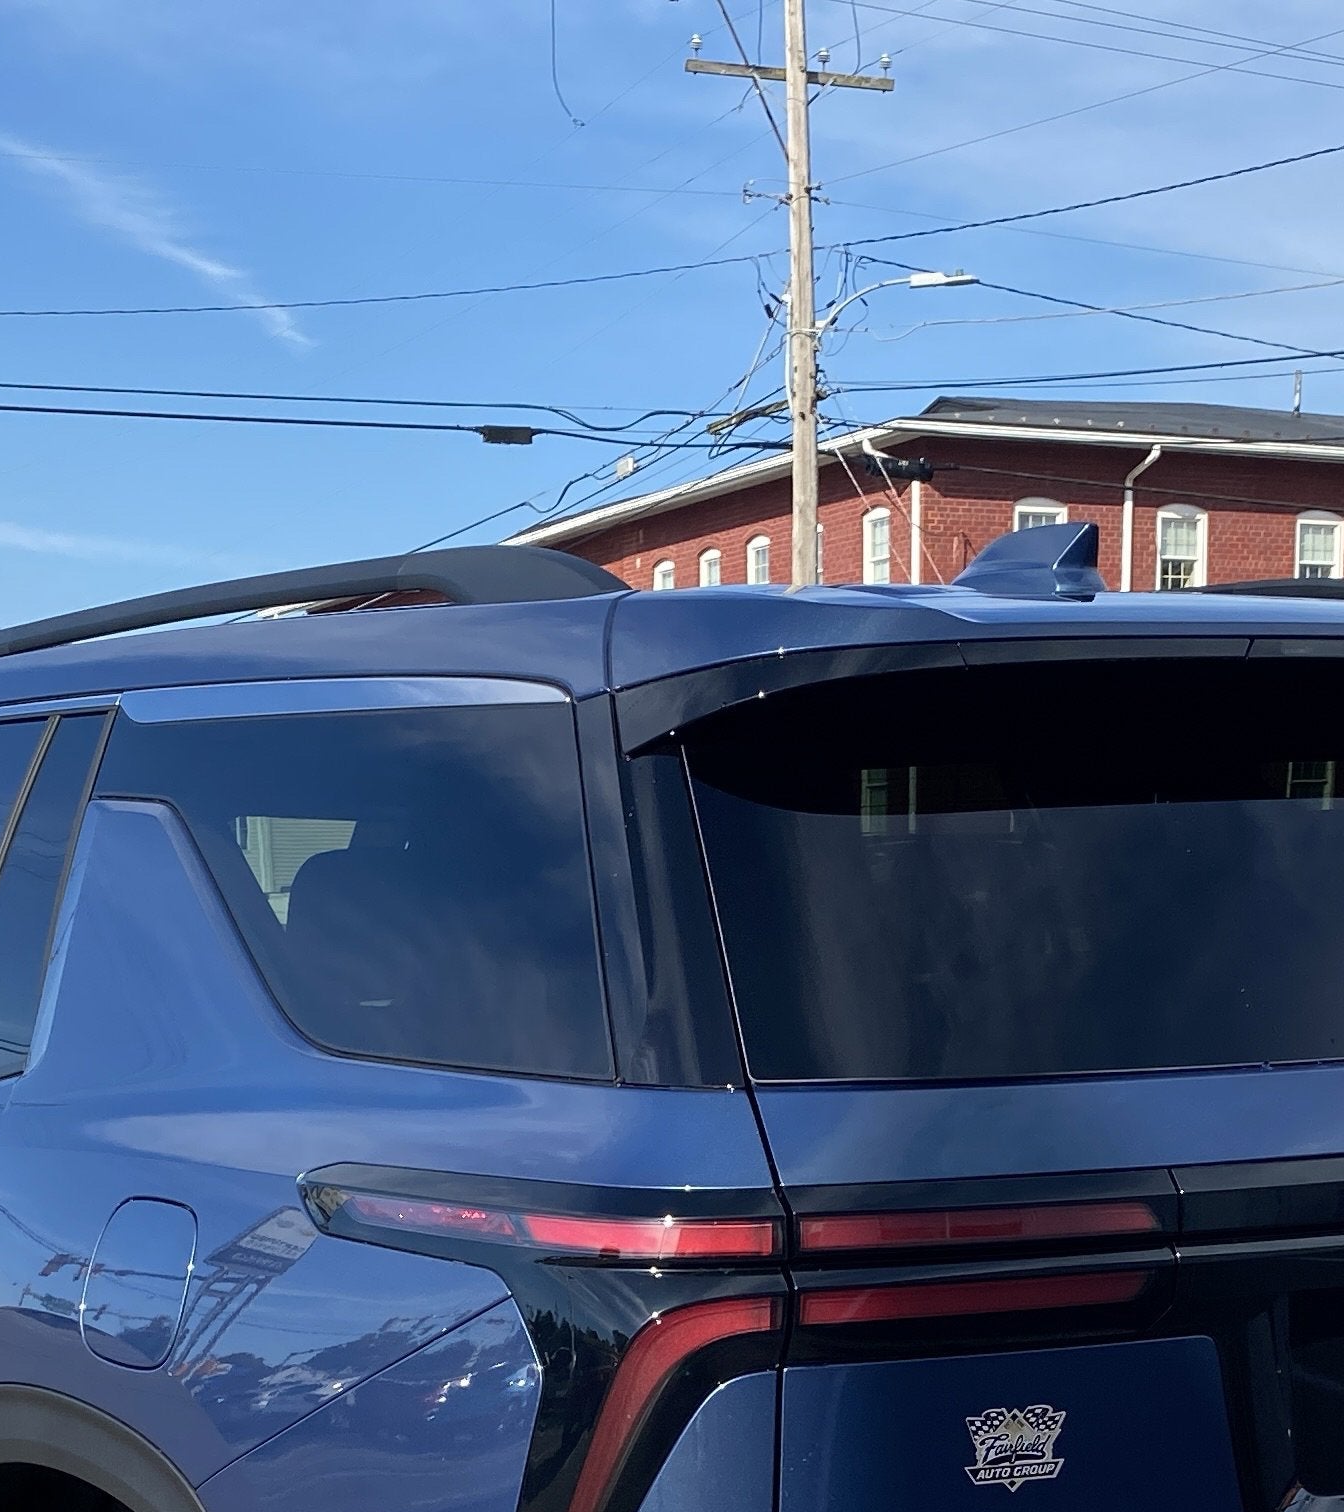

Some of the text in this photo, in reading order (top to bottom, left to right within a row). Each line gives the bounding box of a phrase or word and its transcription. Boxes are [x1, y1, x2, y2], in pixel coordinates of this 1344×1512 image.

[979, 1433, 1051, 1465] Fairfield
[976, 1463, 1056, 1480] AUTO GROUP
